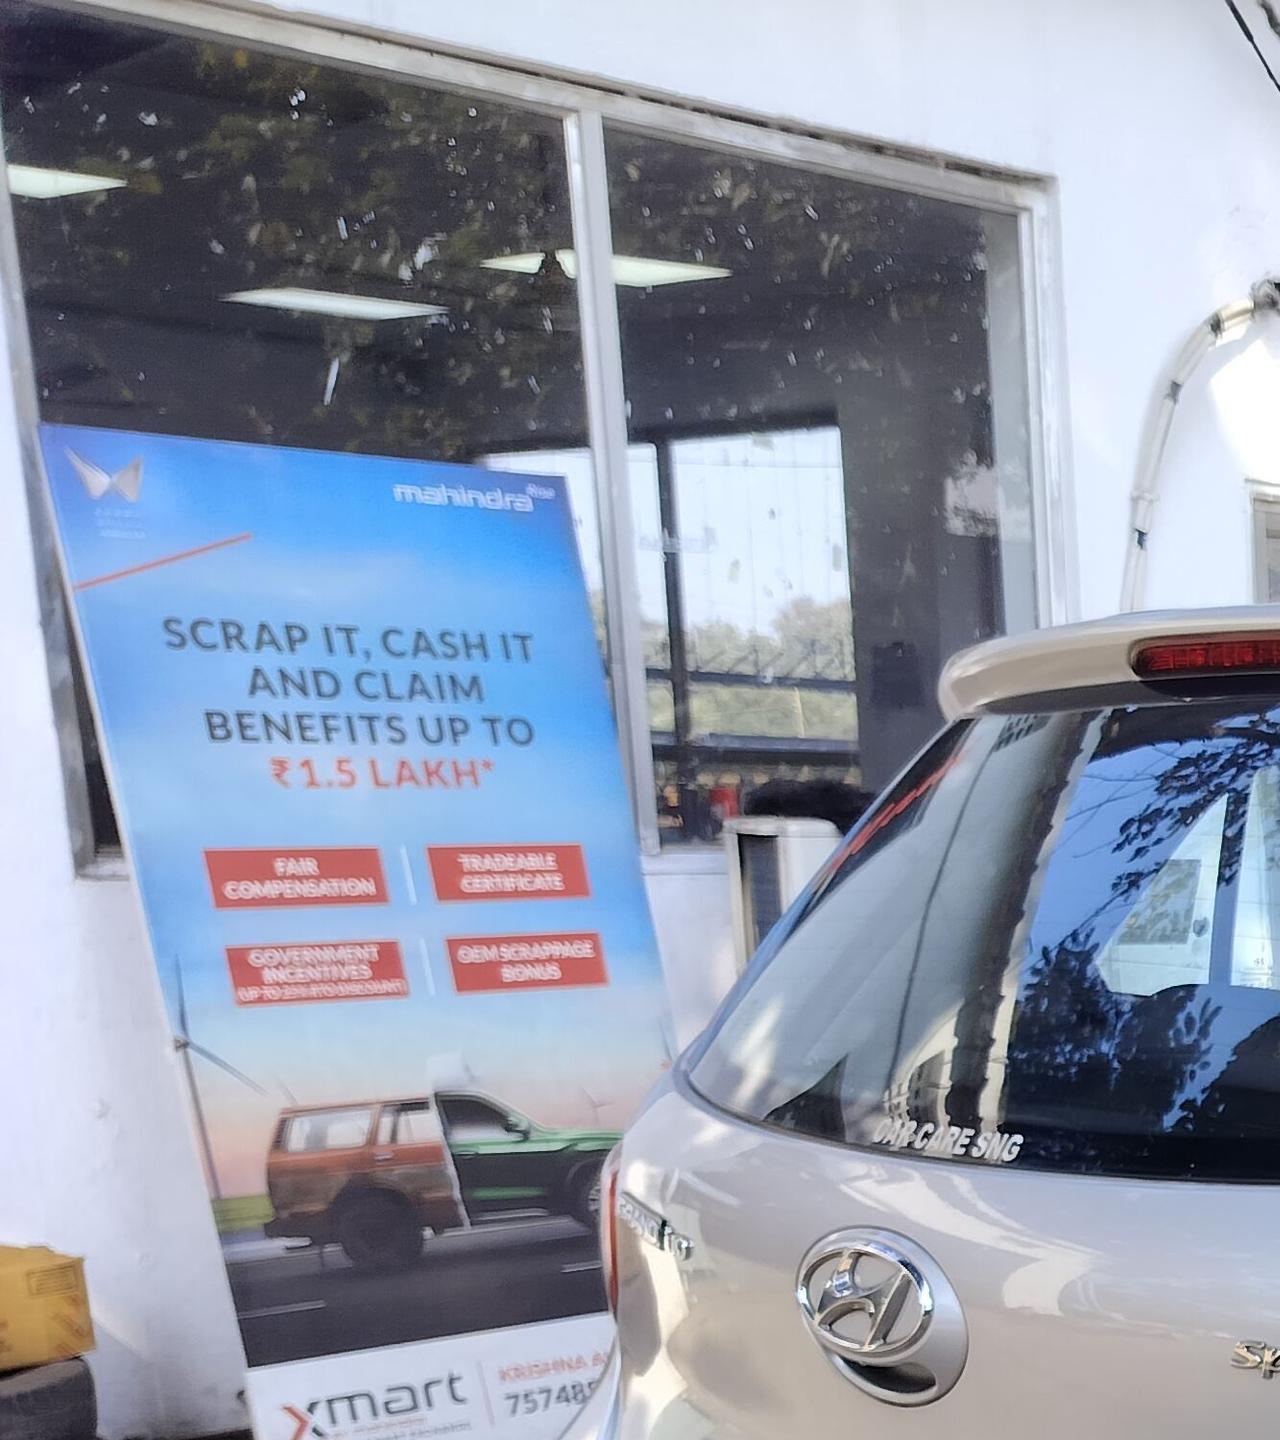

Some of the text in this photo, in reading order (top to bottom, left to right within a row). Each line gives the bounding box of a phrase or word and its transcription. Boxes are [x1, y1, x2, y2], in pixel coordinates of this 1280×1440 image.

[393, 484, 534, 512] mahindra
[162, 618, 533, 663] SCRAP IT, CASH IT
[248, 665, 485, 704] AND CLAIM
[203, 708, 535, 746] BENEFITS UP TO
[273, 857, 320, 876] FAIR
[457, 852, 558, 872] TRADEABLE
[223, 878, 377, 900] COMPENSATION
[461, 873, 565, 893] CERTIFICATE
[247, 944, 380, 967] GOVERNMENT
[457, 945, 499, 964] OEM
[262, 963, 373, 985] INCENTIVES
[500, 962, 562, 983] BONUS
